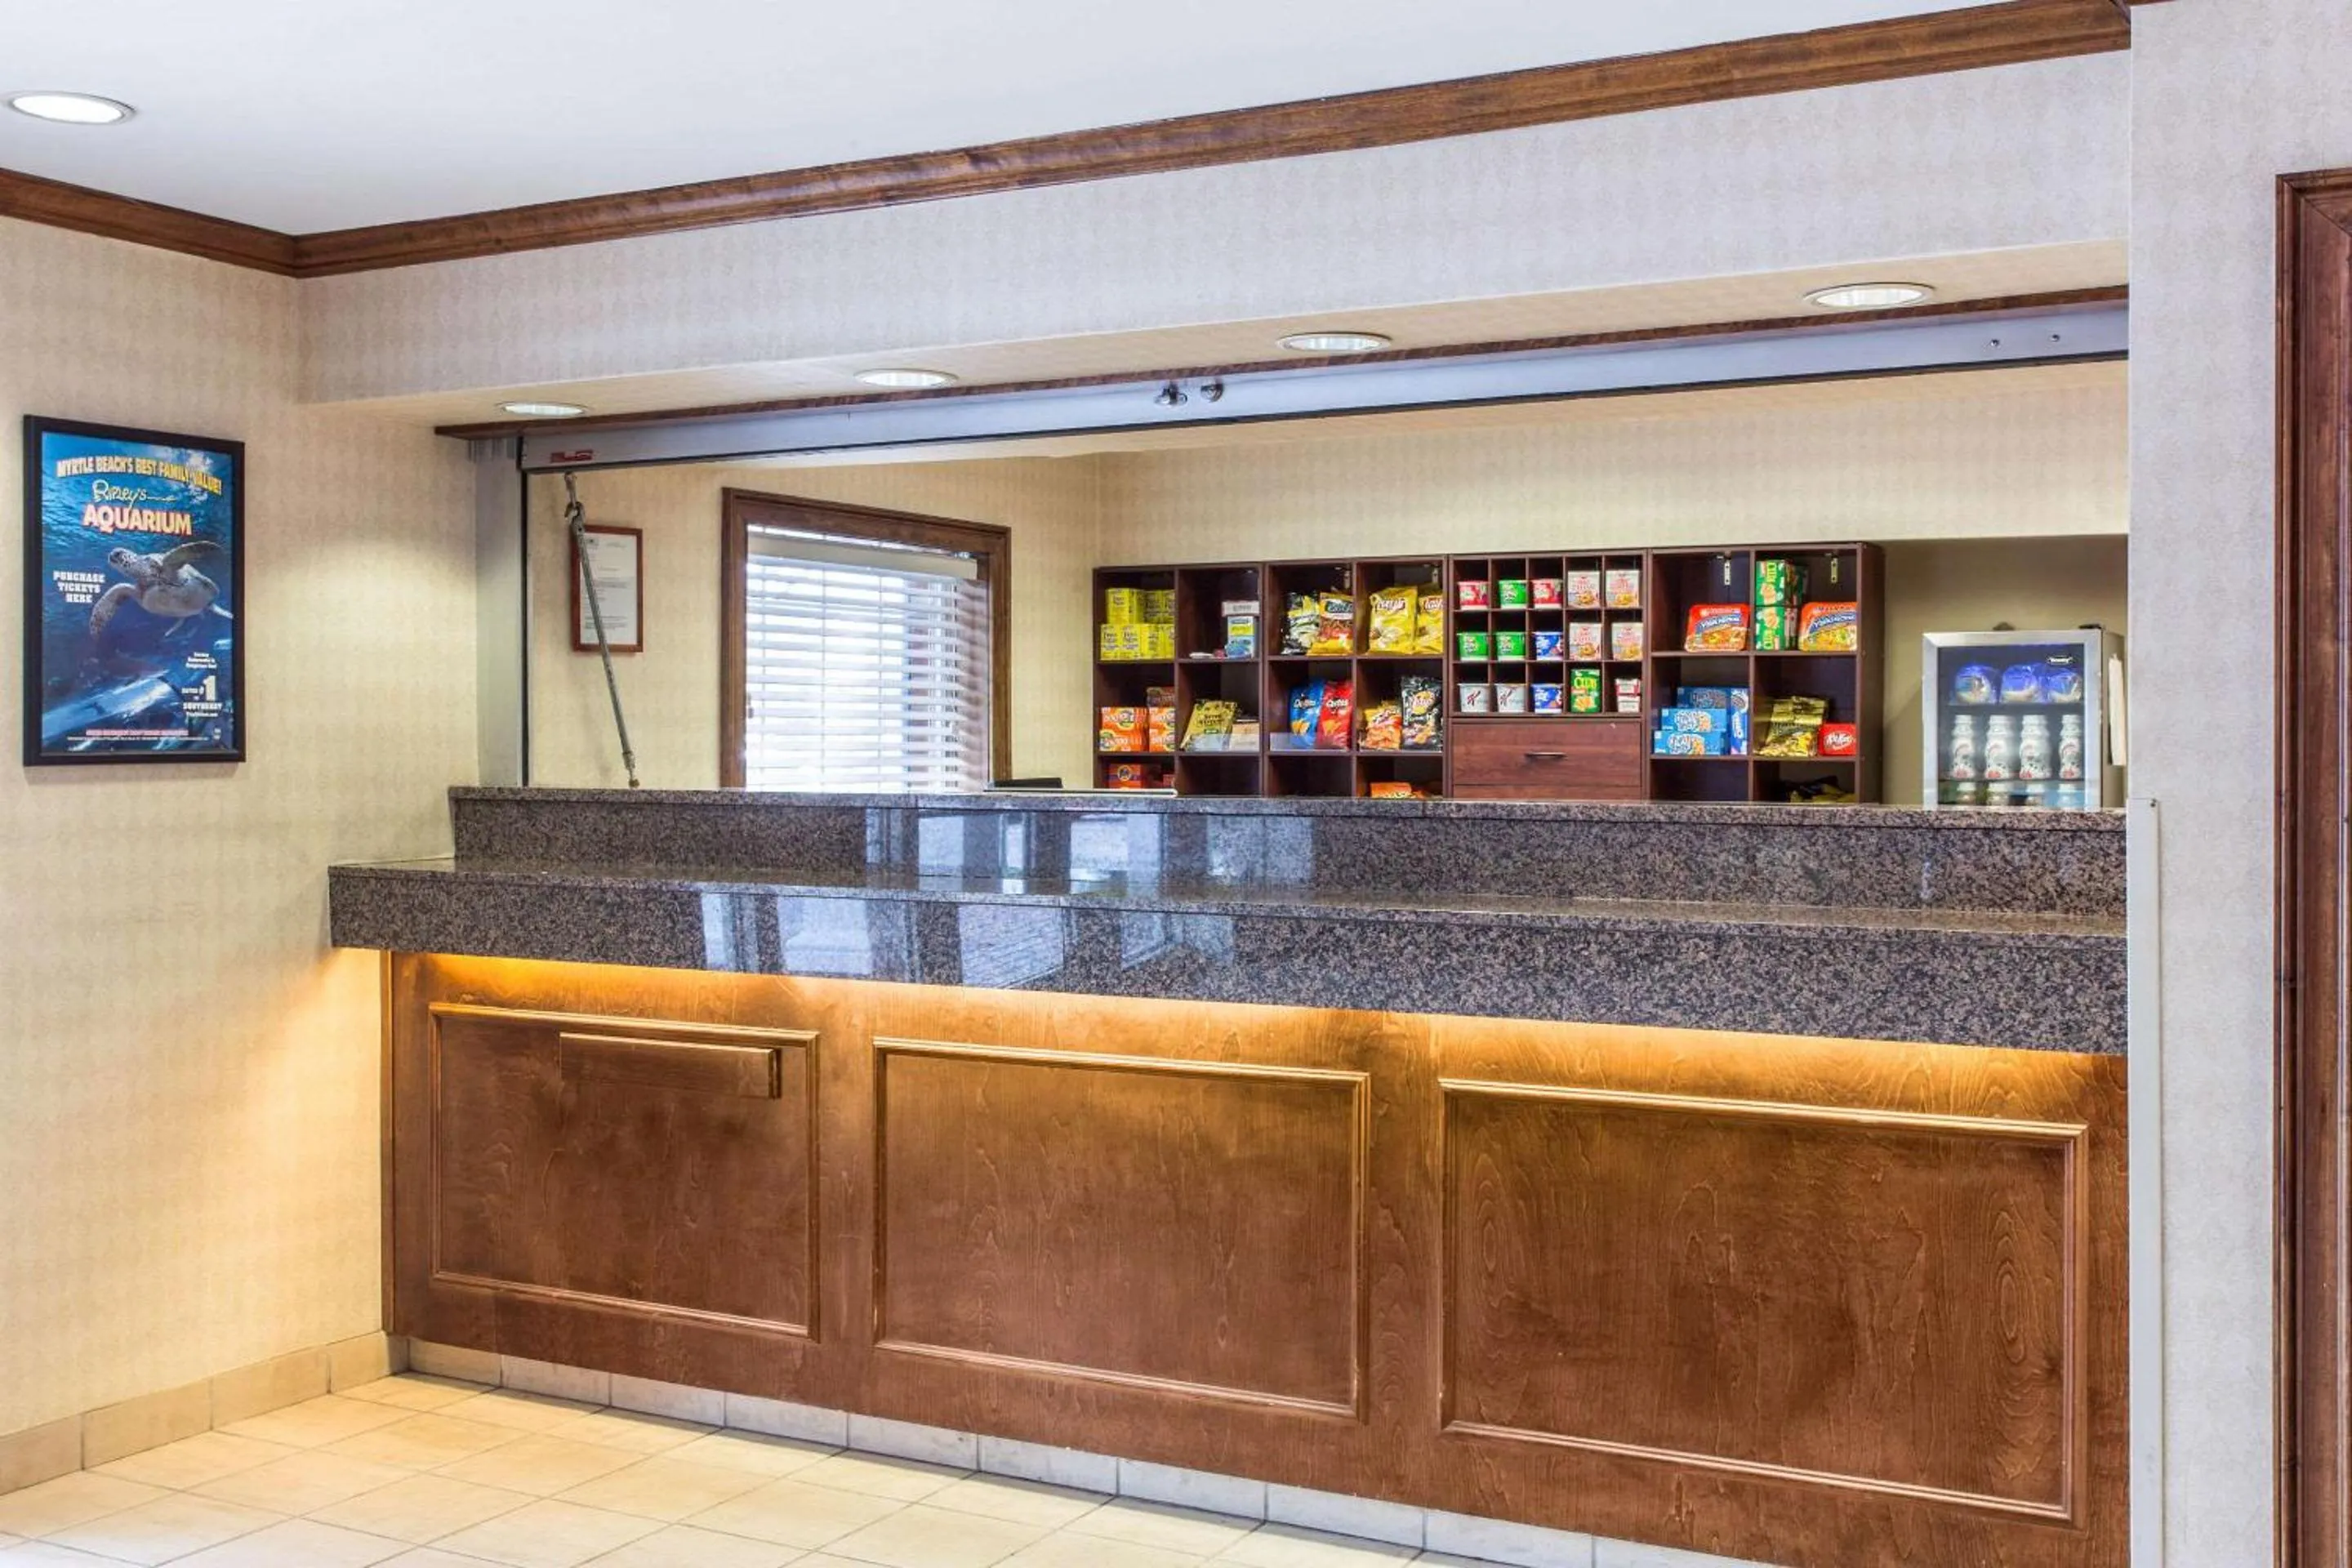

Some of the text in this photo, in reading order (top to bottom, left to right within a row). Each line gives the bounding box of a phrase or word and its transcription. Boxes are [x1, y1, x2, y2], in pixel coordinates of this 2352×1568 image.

[56, 457, 94, 477] MYRTLE
[95, 455, 133, 473] BEACH'S
[134, 457, 158, 474] BEST
[158, 462, 190, 483] FAMILY
[82, 503, 193, 536] AQUARIUM
[53, 570, 106, 583] PURCHASE
[57, 581, 101, 594] TICKETS
[65, 593, 93, 603] HERE
